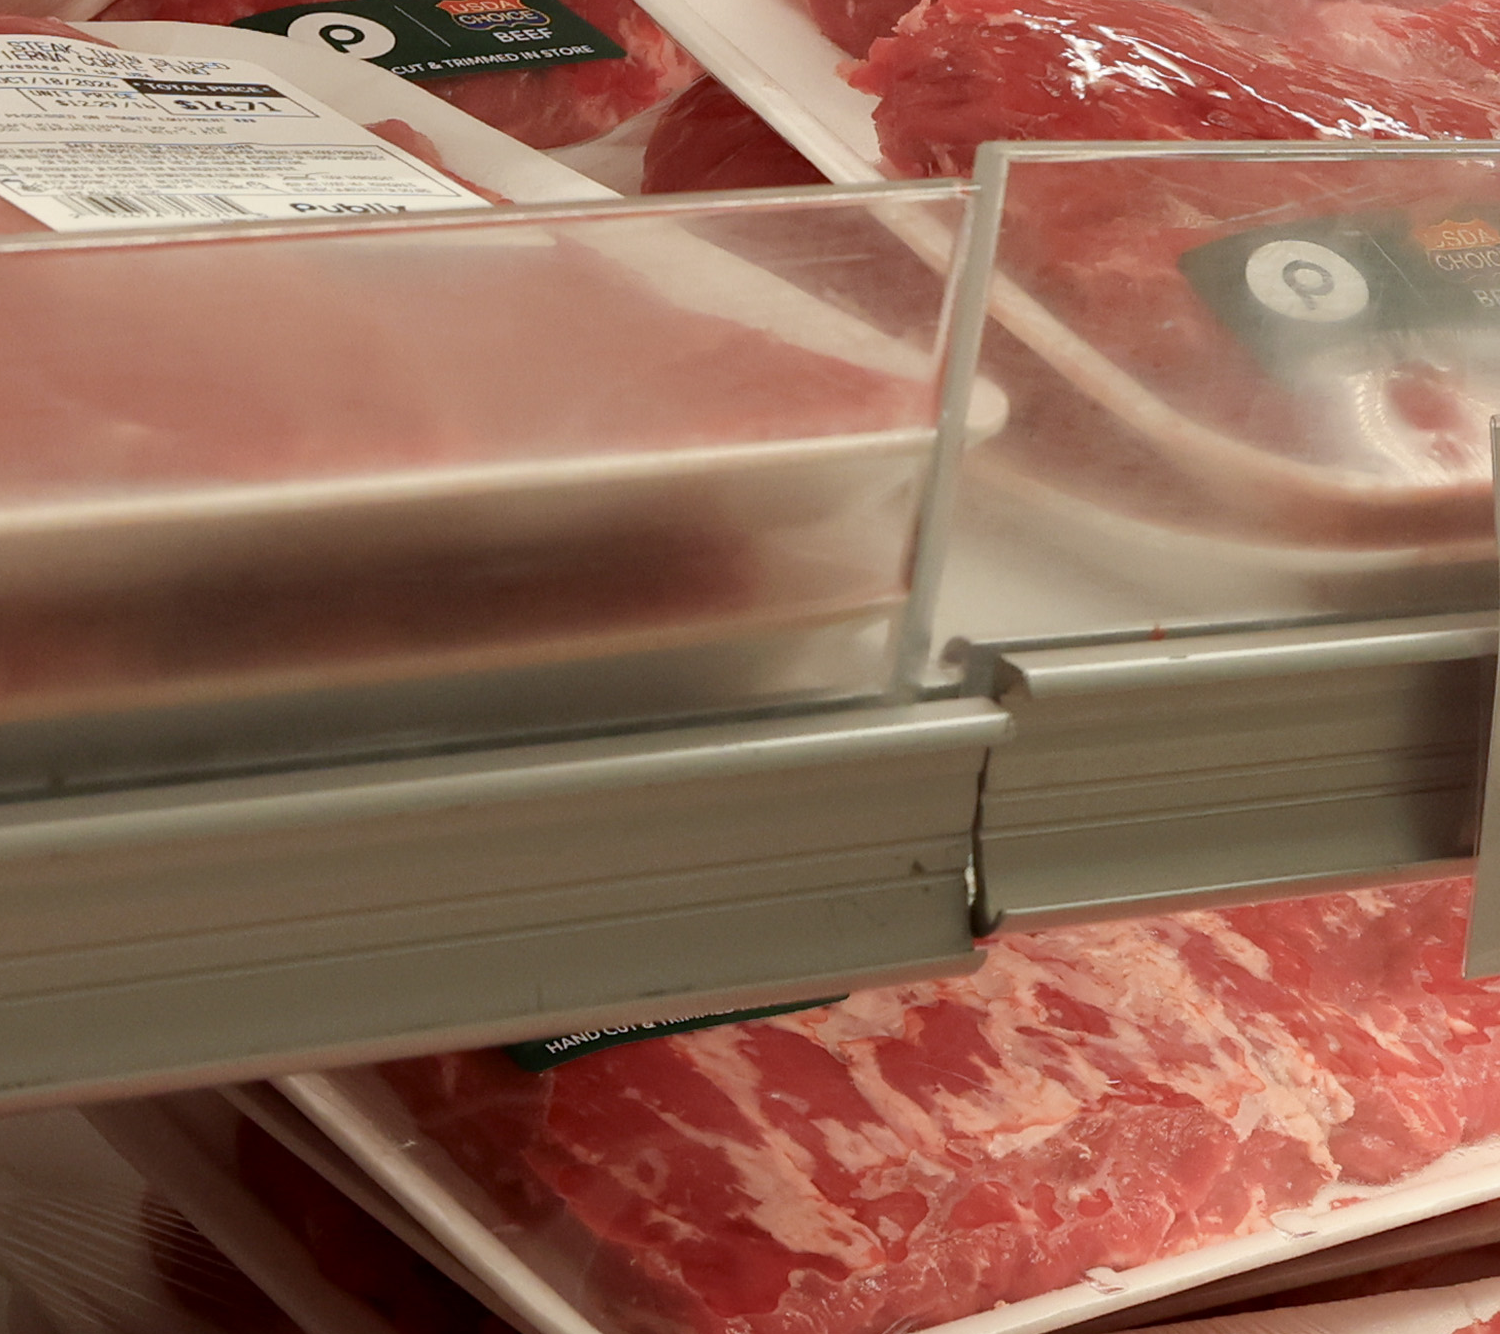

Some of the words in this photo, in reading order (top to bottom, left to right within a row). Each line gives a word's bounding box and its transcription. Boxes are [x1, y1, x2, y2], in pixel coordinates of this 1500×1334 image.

[455, 8, 539, 26] CHOICE
[492, 27, 554, 44] BEEF
[7, 40, 78, 54] STEAK
[391, 60, 427, 76] CUT
[429, 60, 442, 70] &
[440, 52, 519, 68] TRIMMED
[518, 50, 537, 61] IN
[538, 44, 595, 59] STORE
[28, 89, 72, 98] UNIT
[147, 83, 204, 93] TOTAL
[208, 84, 261, 93] PRICE
[173, 99, 283, 113] $16.71
[544, 1029, 601, 1056] HAND
